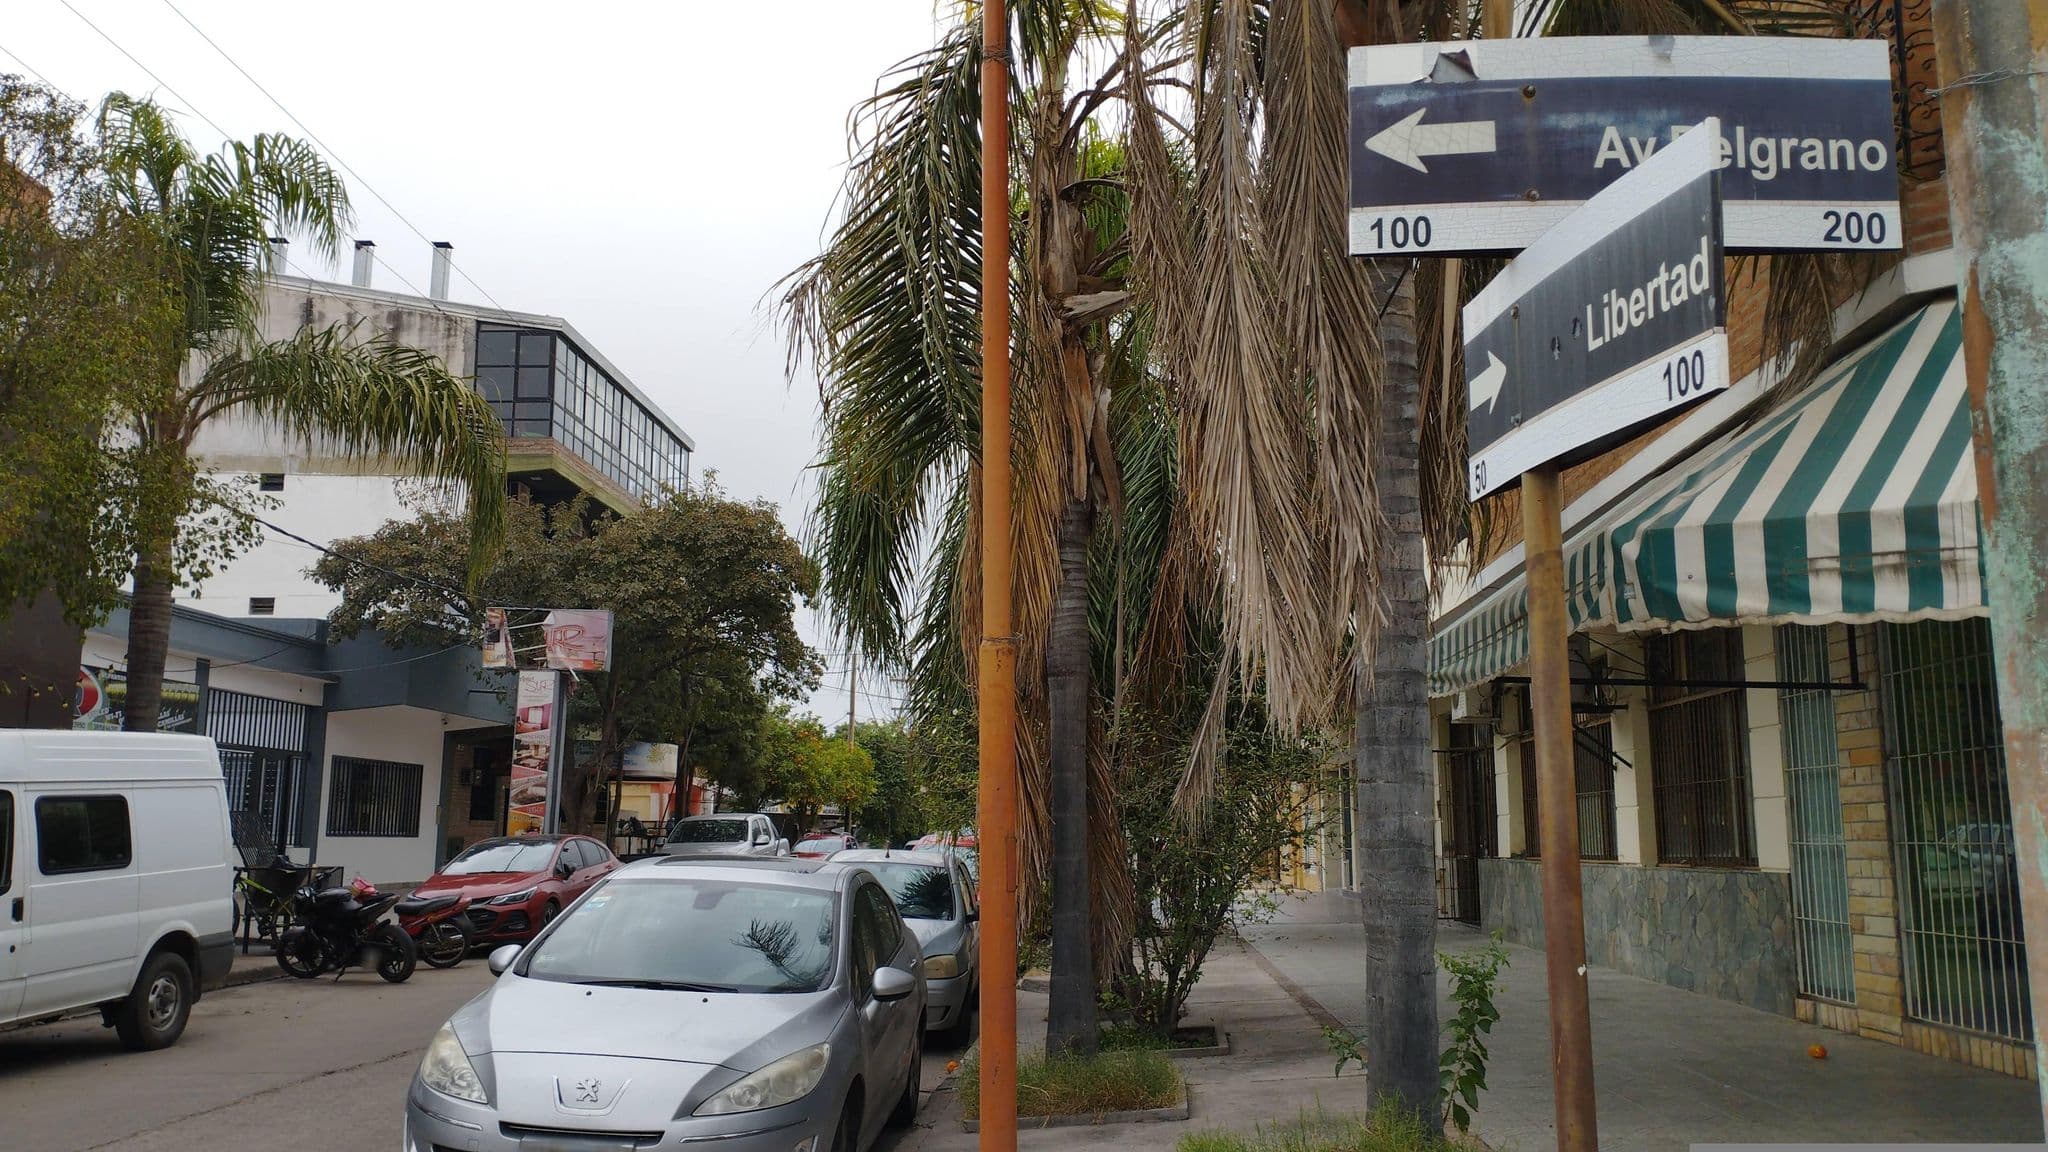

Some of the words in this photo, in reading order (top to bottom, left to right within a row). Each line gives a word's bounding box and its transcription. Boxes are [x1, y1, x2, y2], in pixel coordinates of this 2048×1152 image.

[1670, 126, 1888, 180] elgrano
[1369, 215, 1432, 249] 100
[1823, 210, 1886, 244] 200
[1586, 236, 1710, 352] Libertad
[1663, 350, 1705, 401] 100
[1475, 460, 1487, 494] 50
